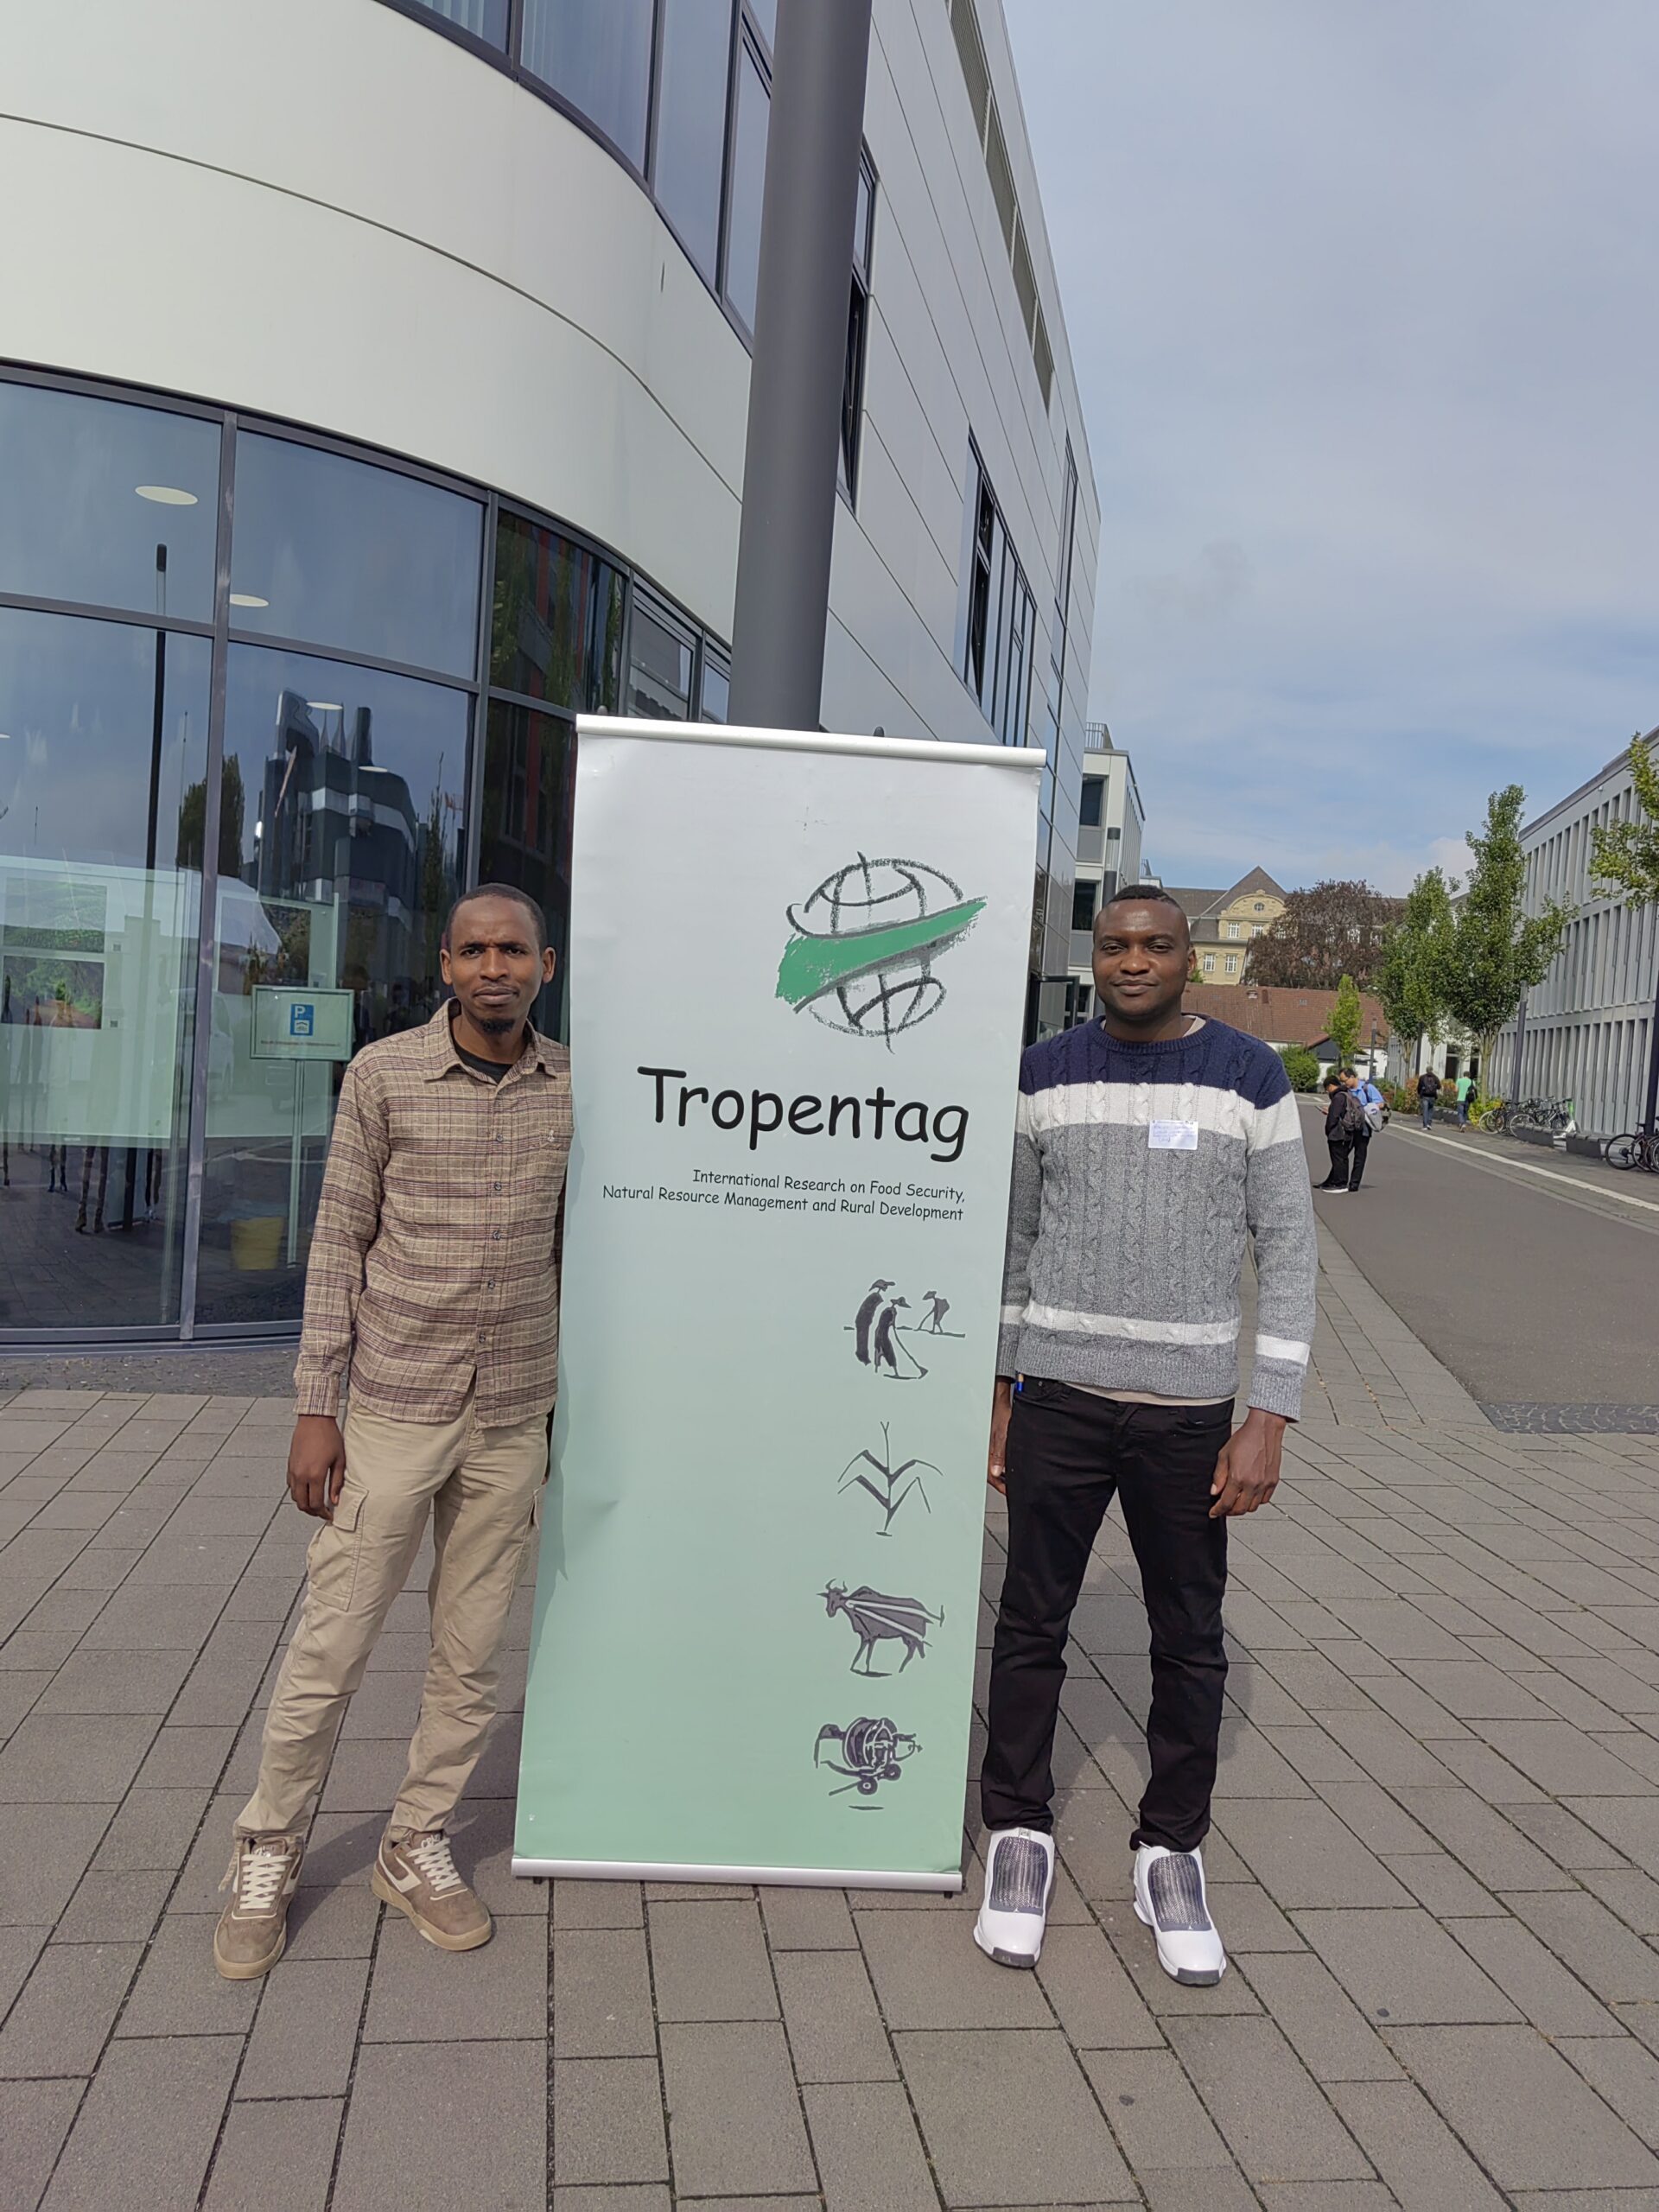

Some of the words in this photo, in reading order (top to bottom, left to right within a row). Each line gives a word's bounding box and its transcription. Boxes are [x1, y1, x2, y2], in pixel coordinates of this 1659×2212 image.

[295, 1005, 306, 1018] P
[638, 1065, 969, 1163] Tropentag
[603, 1185, 654, 1199] Natural
[658, 1186, 720, 1204] Resource
[724, 1192, 809, 1211] Management
[812, 1198, 836, 1212] and
[841, 1198, 875, 1214] Rural
[880, 1201, 963, 1222] Development
[692, 1169, 779, 1188] International
[785, 1175, 846, 1192] Research
[849, 1183, 865, 1193] on
[870, 1180, 901, 1196] Food
[906, 1183, 965, 1205] Security,
